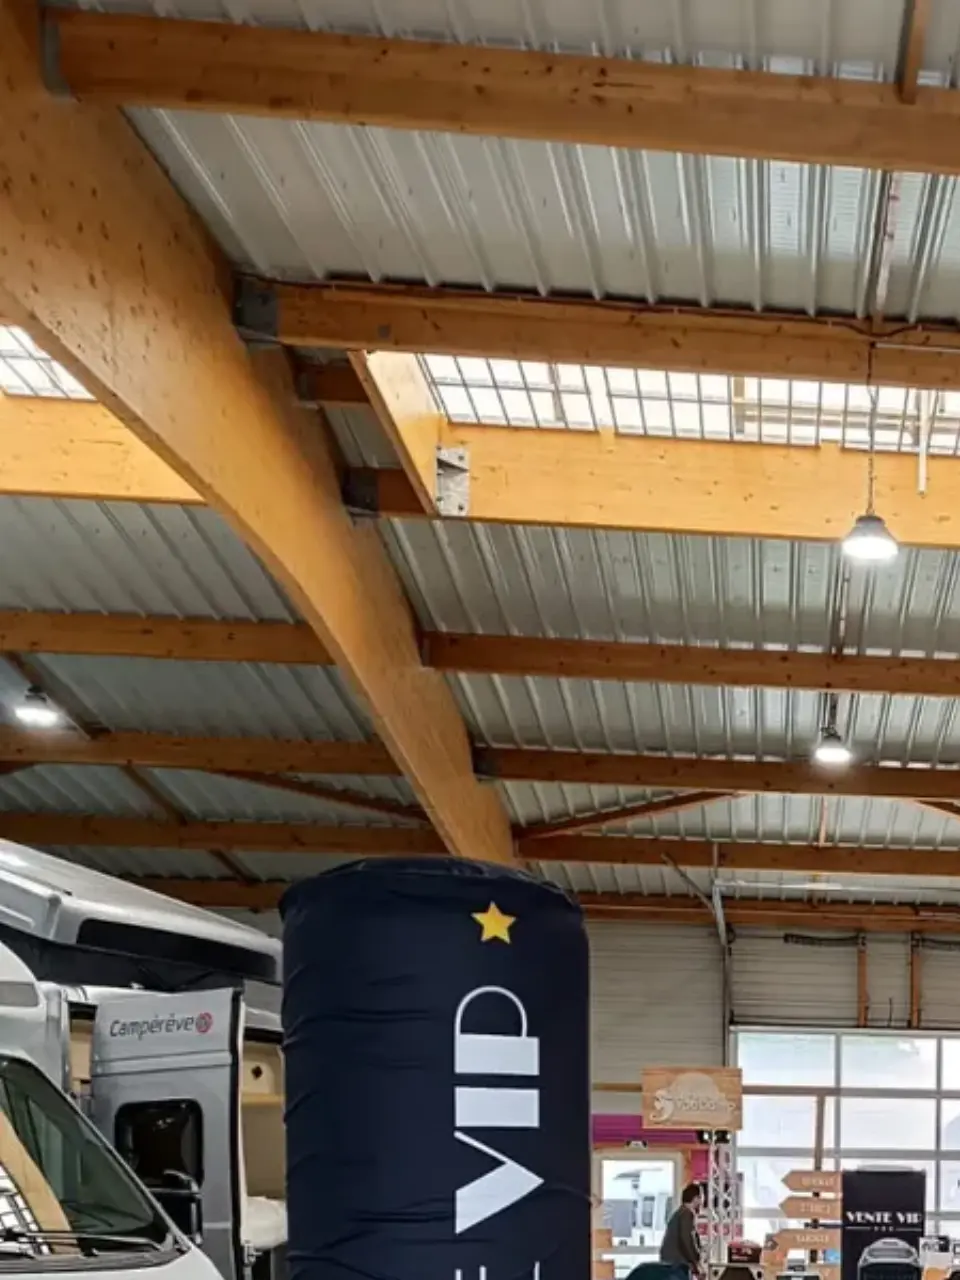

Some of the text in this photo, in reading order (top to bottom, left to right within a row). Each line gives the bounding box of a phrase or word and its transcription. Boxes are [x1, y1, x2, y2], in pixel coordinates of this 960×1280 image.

[110, 1013, 195, 1040] Campérêve
[454, 985, 545, 1235] VIP
[845, 1211, 924, 1224] VENTE VIP
